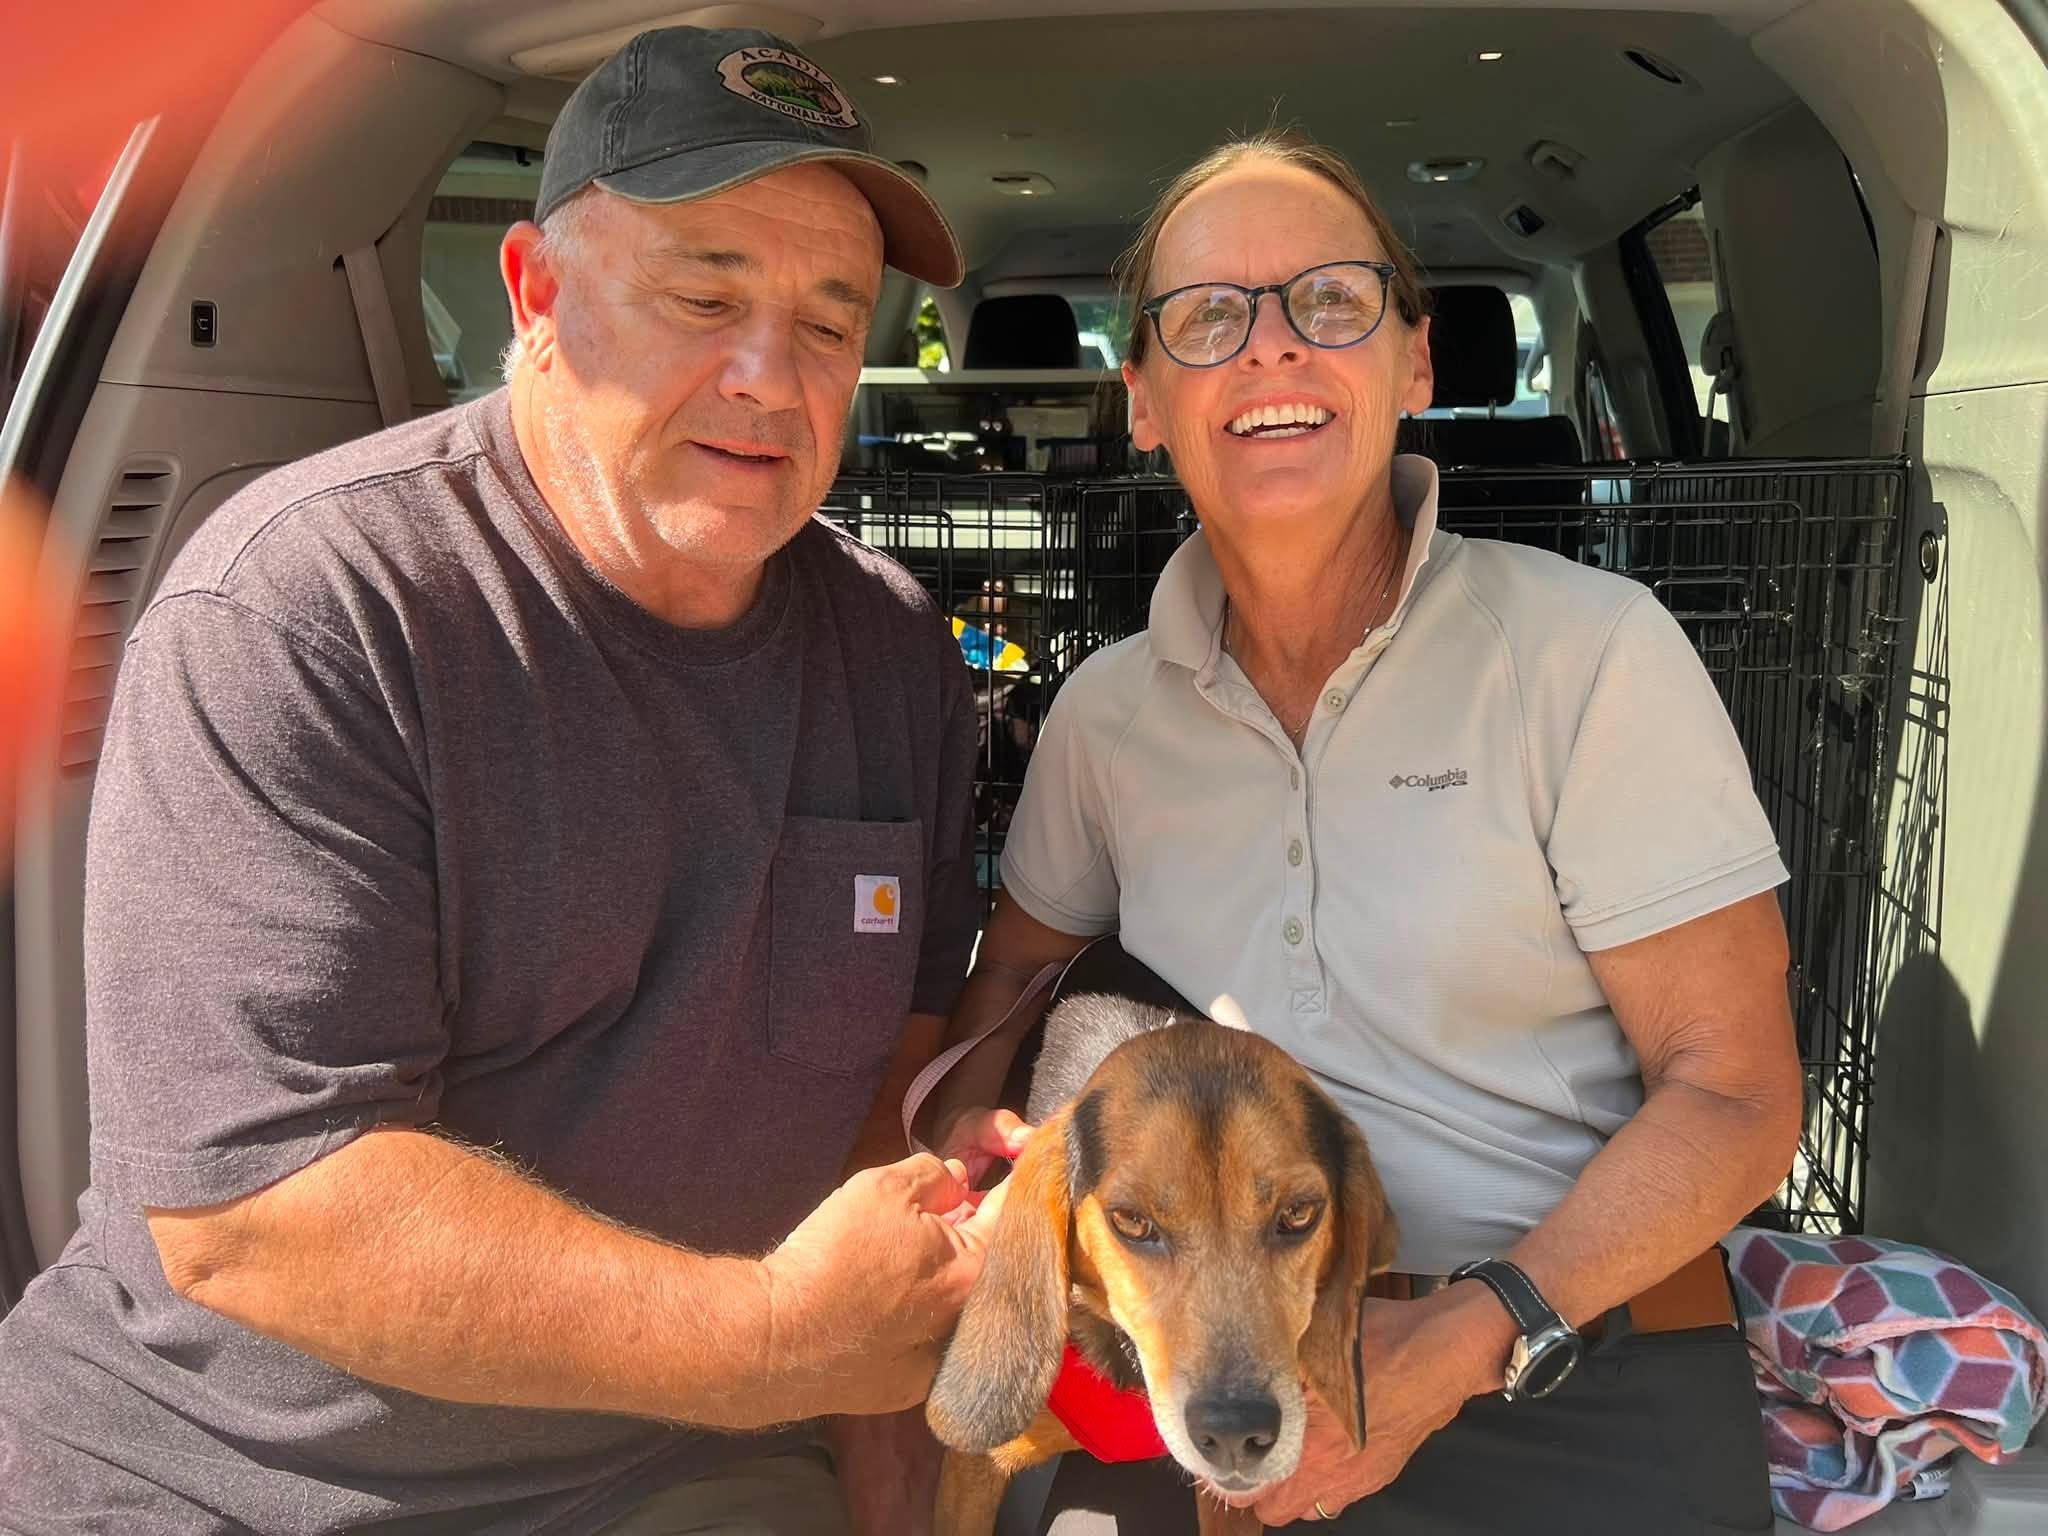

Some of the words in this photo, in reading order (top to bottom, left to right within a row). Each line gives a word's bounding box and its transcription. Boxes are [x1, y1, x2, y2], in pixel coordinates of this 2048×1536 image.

[740, 49, 834, 91] ACADIA
[750, 91, 821, 121] NATIONAL
[1406, 768, 1468, 787] Columbia
